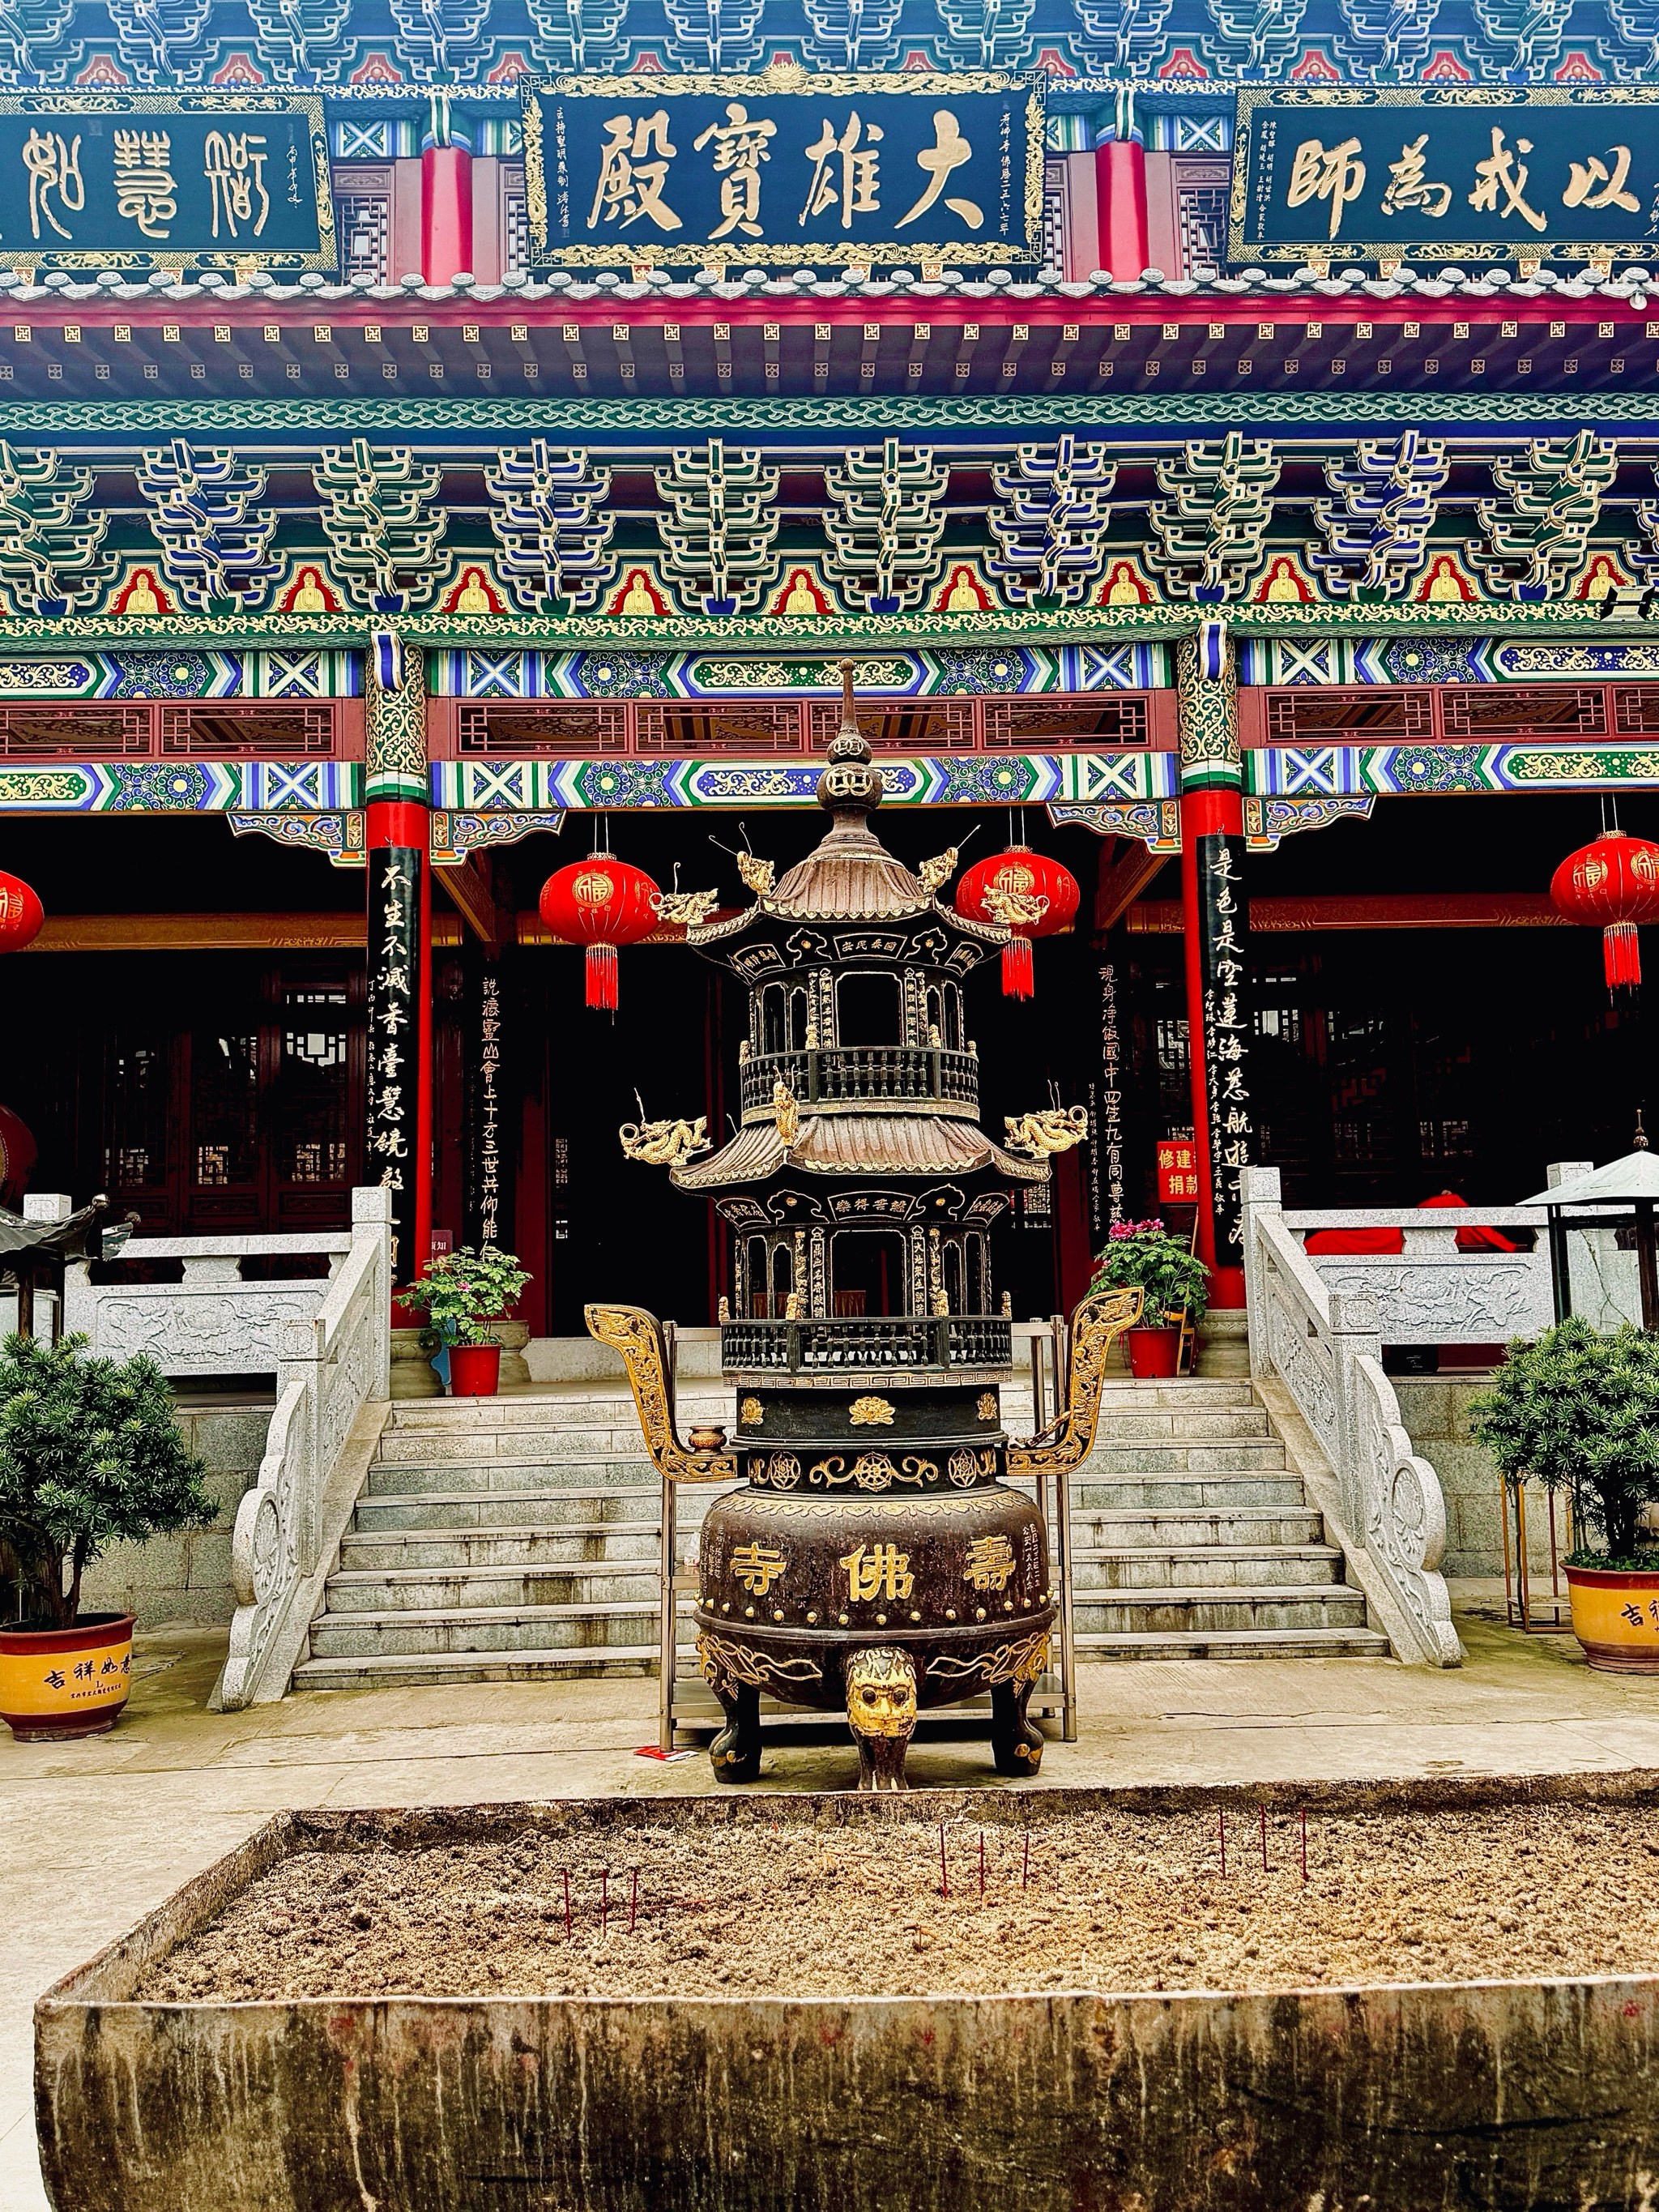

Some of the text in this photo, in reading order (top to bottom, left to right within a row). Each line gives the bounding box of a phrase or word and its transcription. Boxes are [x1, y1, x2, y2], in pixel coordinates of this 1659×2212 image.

[586, 103, 984, 241] 大雄寶殿
[1286, 126, 1640, 241] 以戒為師
[576, 875, 608, 903] 福
[1573, 861, 1601, 889] 福
[1158, 1149, 1196, 1169] 修建
[1169, 1175, 1197, 1194] 捐款
[731, 1535, 1017, 1601] 壽佛寺
[44, 1654, 130, 1689] 吉祥如意
